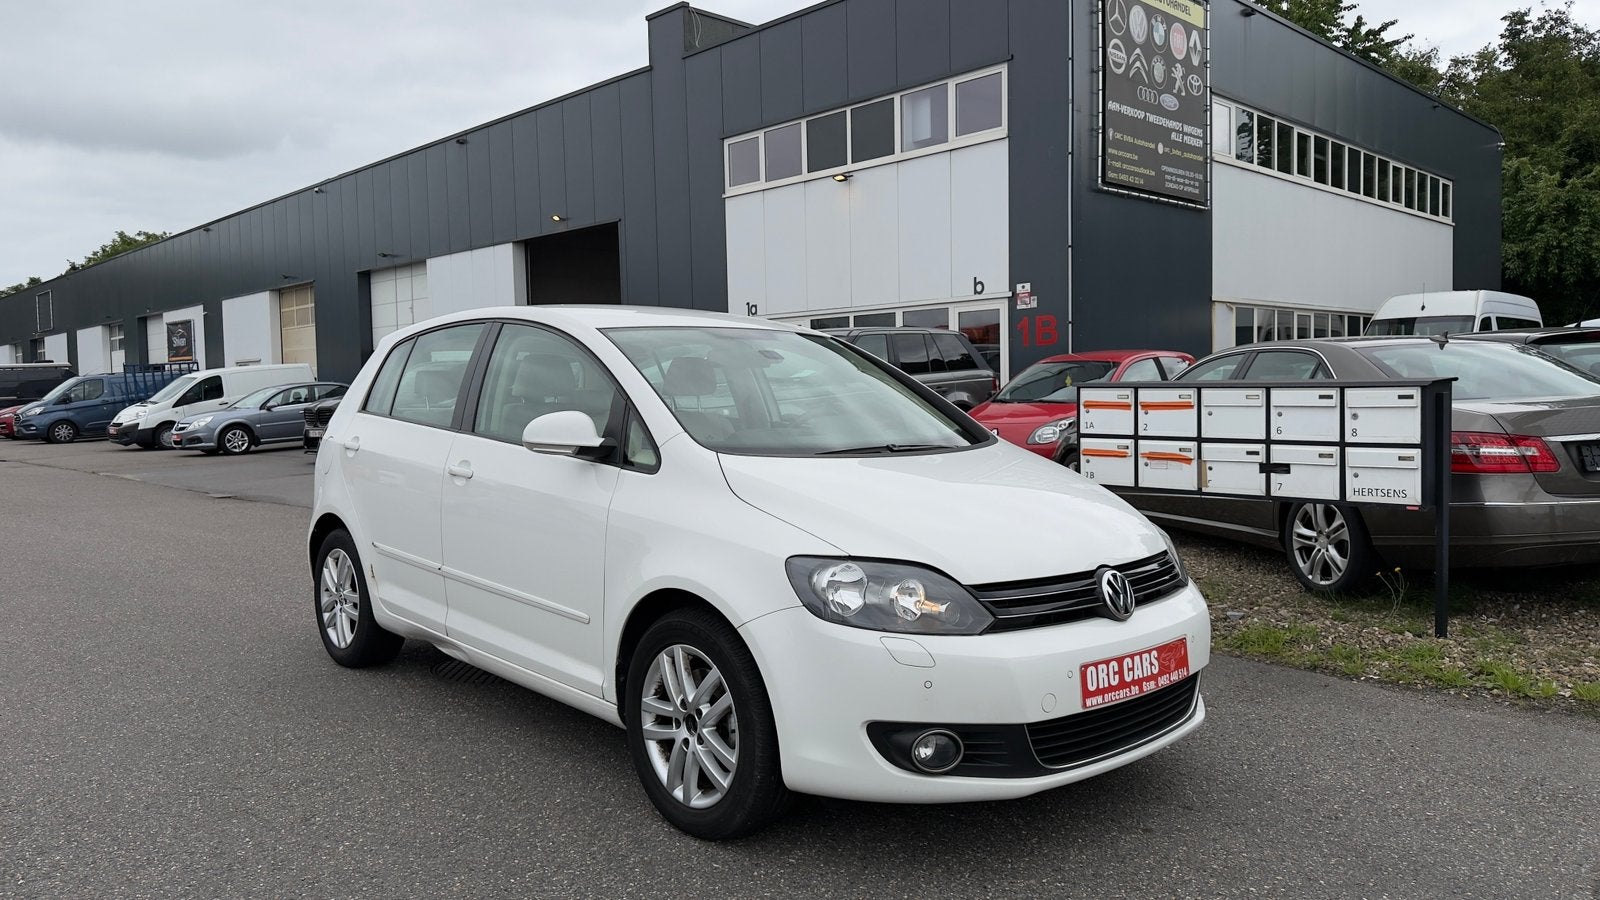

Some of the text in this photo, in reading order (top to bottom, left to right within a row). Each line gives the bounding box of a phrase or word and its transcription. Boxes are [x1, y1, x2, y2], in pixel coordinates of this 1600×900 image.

[1155, 0, 1191, 16] TOHANDEL
[1107, 101, 1203, 137] AAN-VERKOOP TWEEDEHANDS WAGENS
[1171, 132, 1203, 148] ALLE MERKEN
[973, 277, 985, 295] b
[746, 302, 758, 316] 1a
[1017, 315, 1057, 346] 1B
[1085, 421, 1095, 429] 1A
[1276, 427, 1282, 435] 6
[1351, 428, 1358, 437] 8
[1277, 483, 1283, 491] 7
[1353, 487, 1408, 499] HERTSENS
[1086, 650, 1159, 691] ORC CARS
[1086, 685, 1140, 707] www.orccars.be
[1142, 680, 1157, 692] Gsm:
